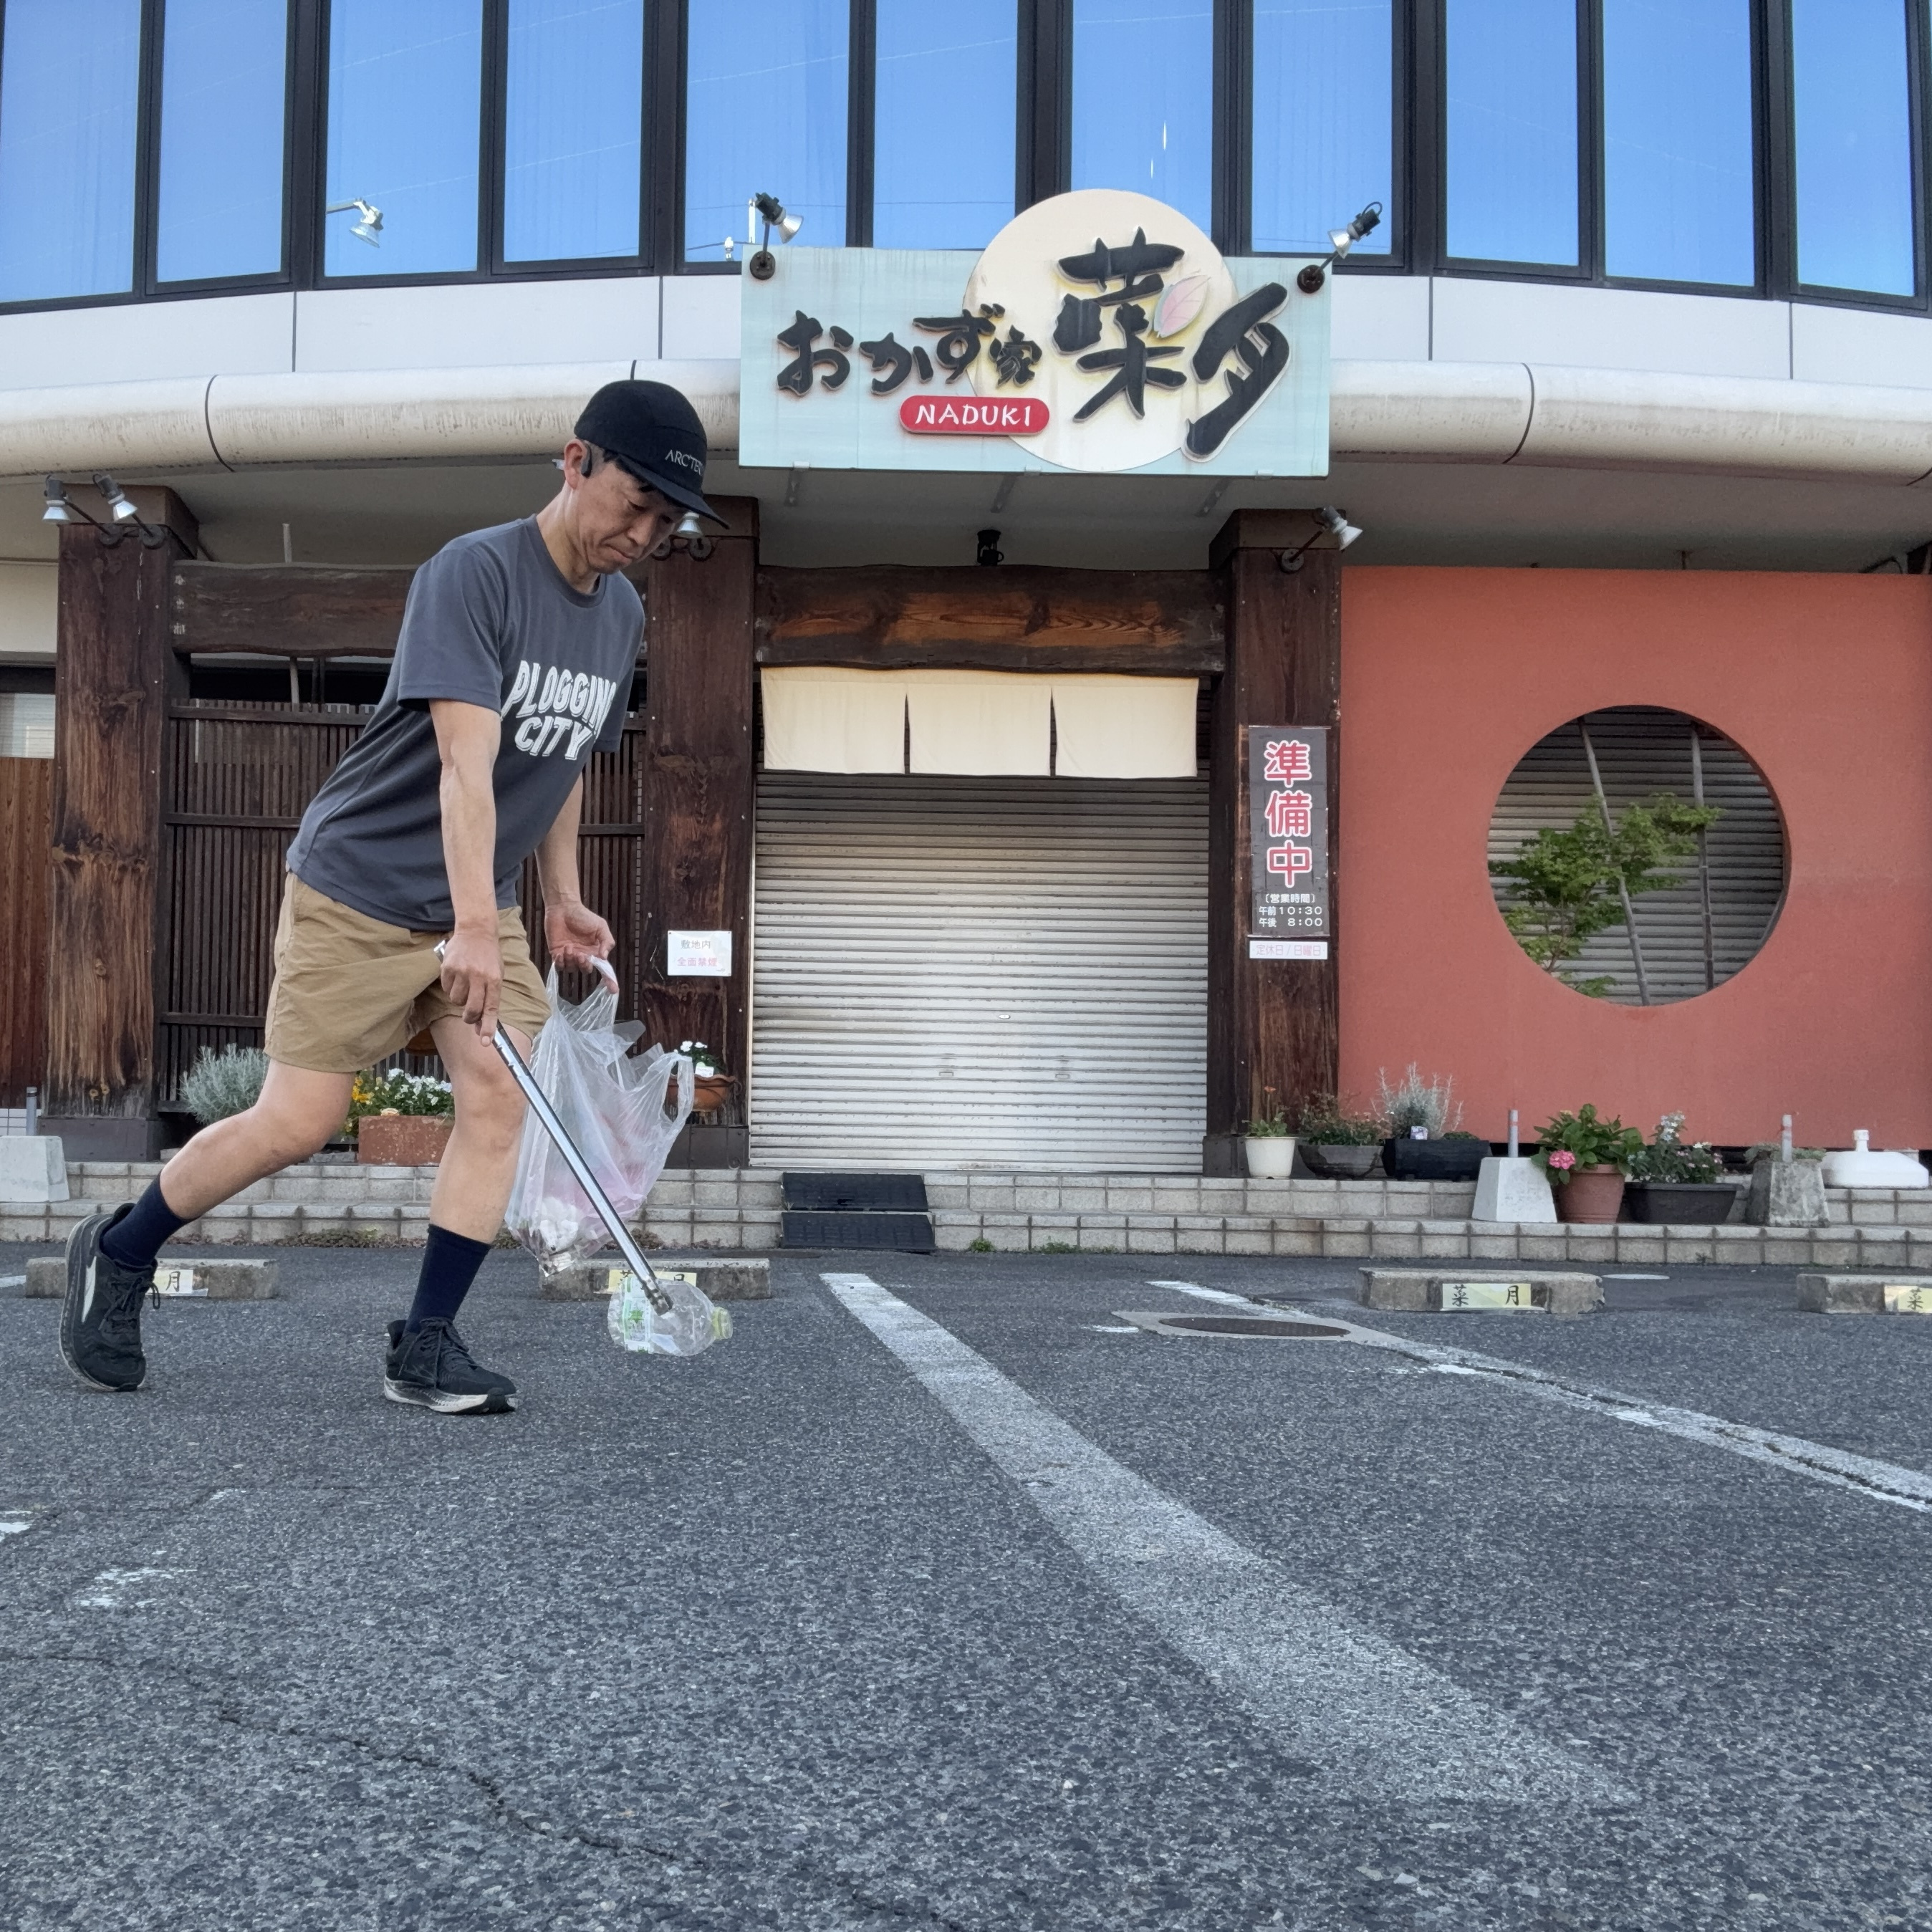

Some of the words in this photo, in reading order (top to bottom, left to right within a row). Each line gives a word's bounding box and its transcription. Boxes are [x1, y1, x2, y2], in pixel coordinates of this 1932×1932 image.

[777, 304, 1042, 395] おかず家
[915, 407, 1031, 428] NADUKI
[515, 716, 592, 760] CITY
[1264, 740, 1312, 888] 準備中
[677, 957, 717, 966] 全面禁煙
[165, 1271, 181, 1292] 月
